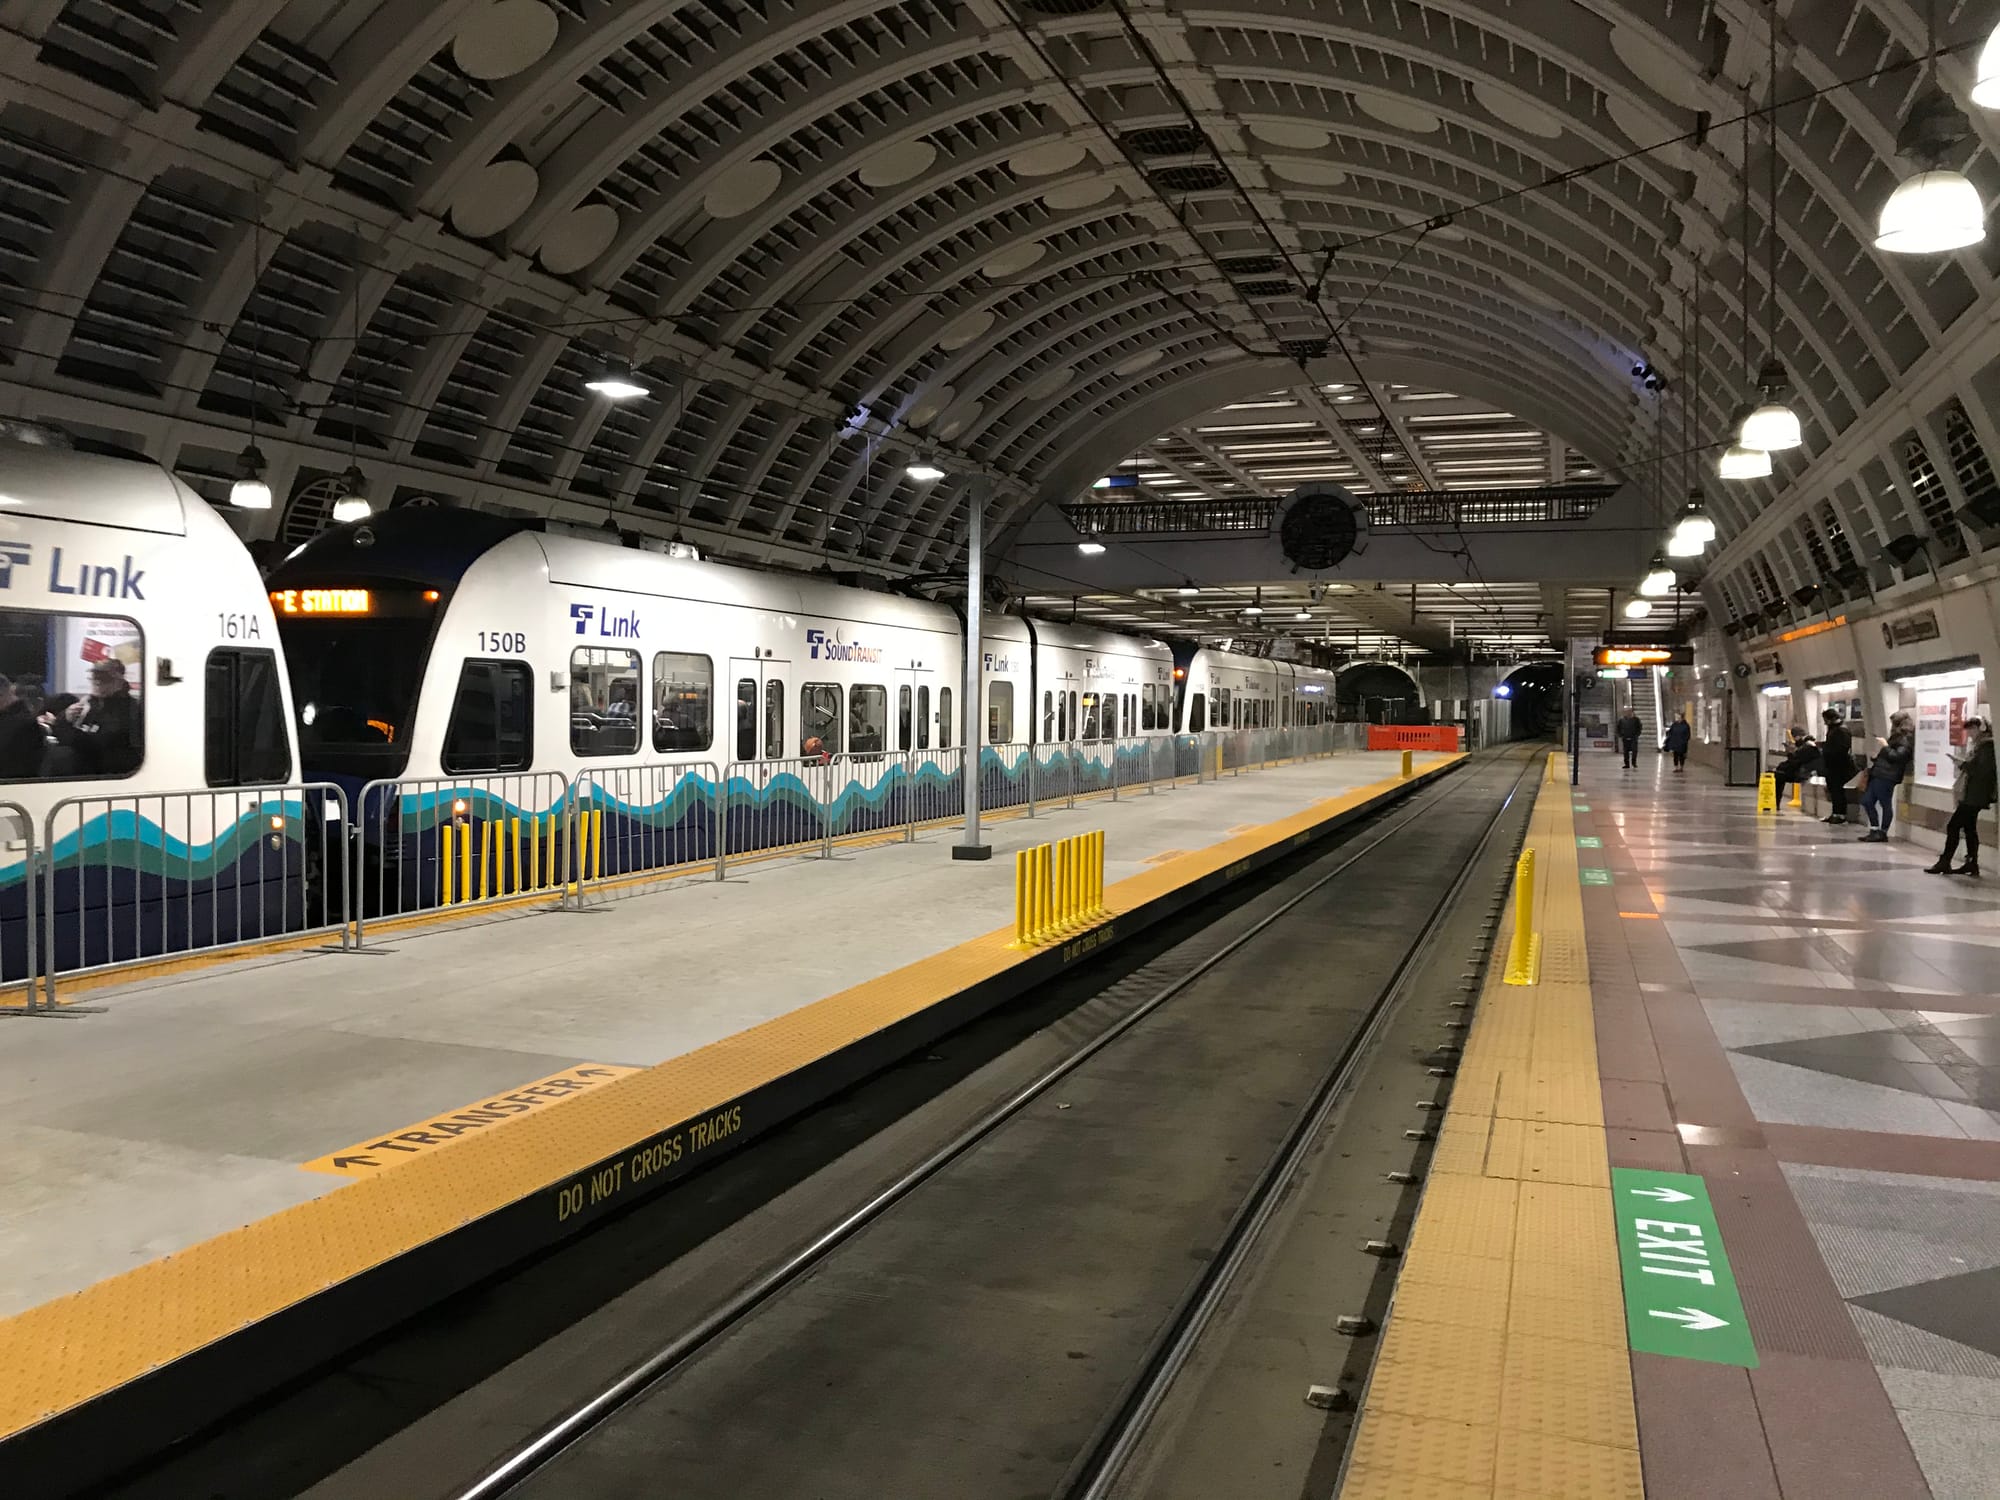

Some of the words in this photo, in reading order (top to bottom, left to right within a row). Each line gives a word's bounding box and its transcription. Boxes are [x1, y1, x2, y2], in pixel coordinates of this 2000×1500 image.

[48, 546, 146, 601] Link
[218, 612, 261, 640] 161A
[478, 631, 526, 654] 150B
[600, 606, 641, 639] Link
[367, 1078, 586, 1153] TRANSFER
[558, 1183, 584, 1222] DO
[590, 1161, 625, 1205] NOT
[631, 1133, 683, 1184] CROSS
[688, 1105, 742, 1153] TRACKS
[1634, 1217, 1716, 1286] EXIT
